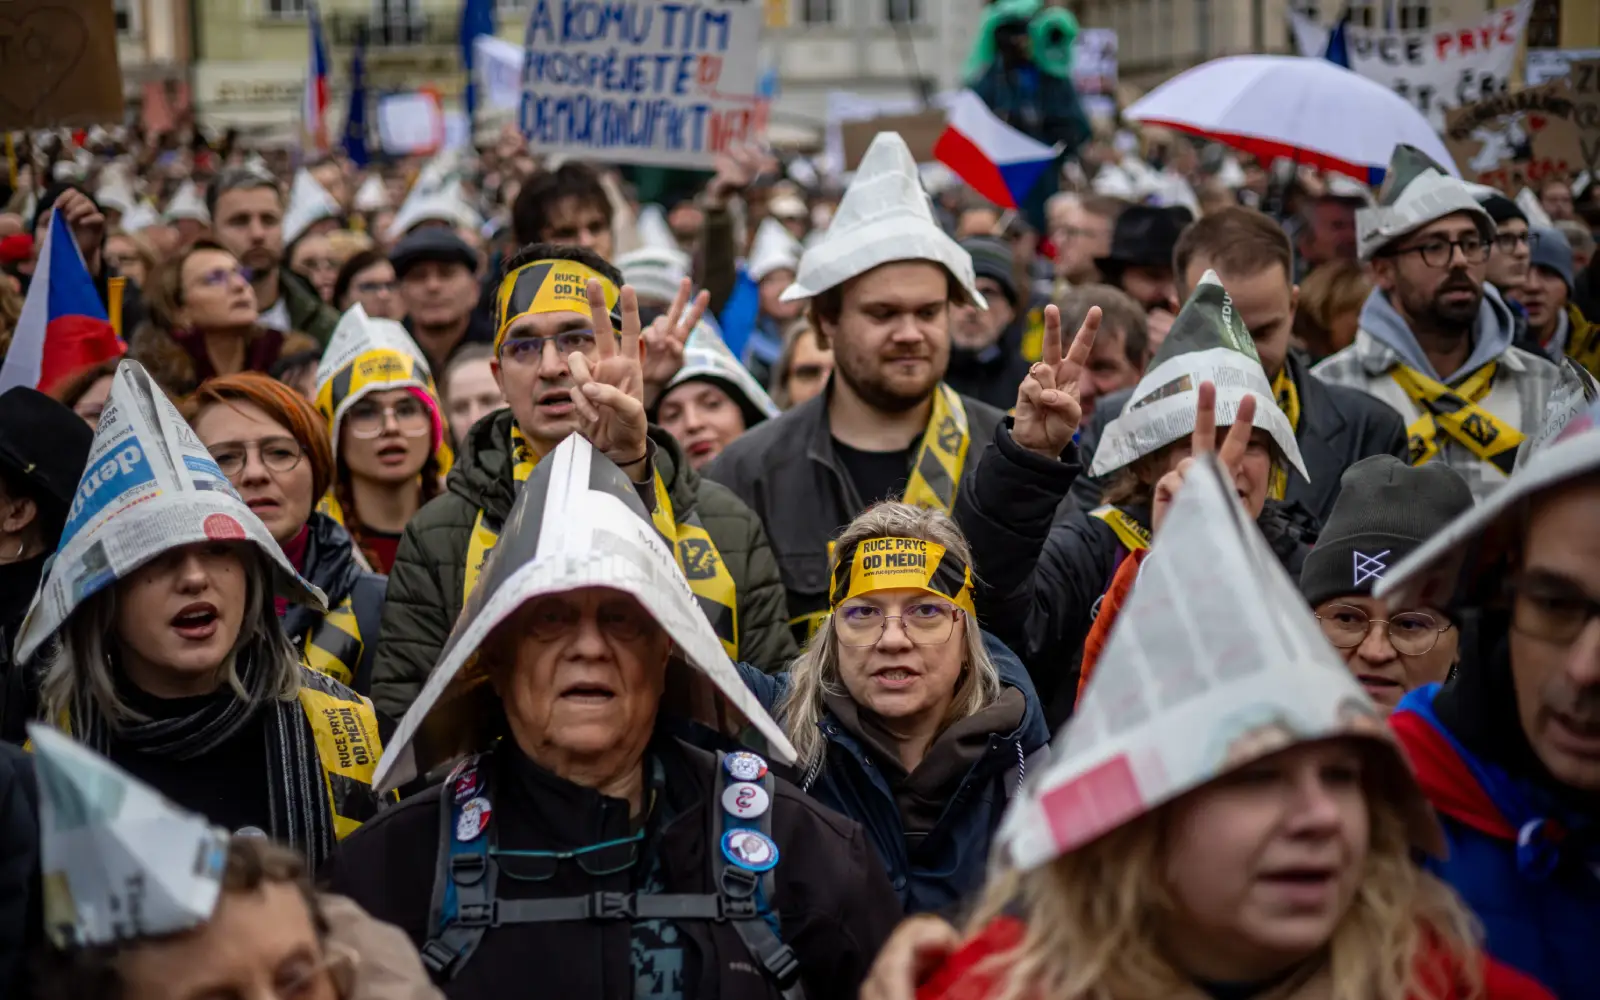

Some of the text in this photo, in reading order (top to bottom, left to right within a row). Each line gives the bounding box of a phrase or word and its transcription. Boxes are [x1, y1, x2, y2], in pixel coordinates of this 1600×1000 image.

[525, 0, 555, 45] A
[560, 0, 653, 45] KOMU
[554, 273, 581, 284] RUCE
[554, 284, 572, 295] OD
[863, 539, 893, 554] RUCE
[863, 550, 927, 570] OD MÉDIÍ
[322, 708, 346, 737] PRYČ
[337, 707, 370, 766] OD MÉDIÍ
[334, 737, 352, 769] RUCE
